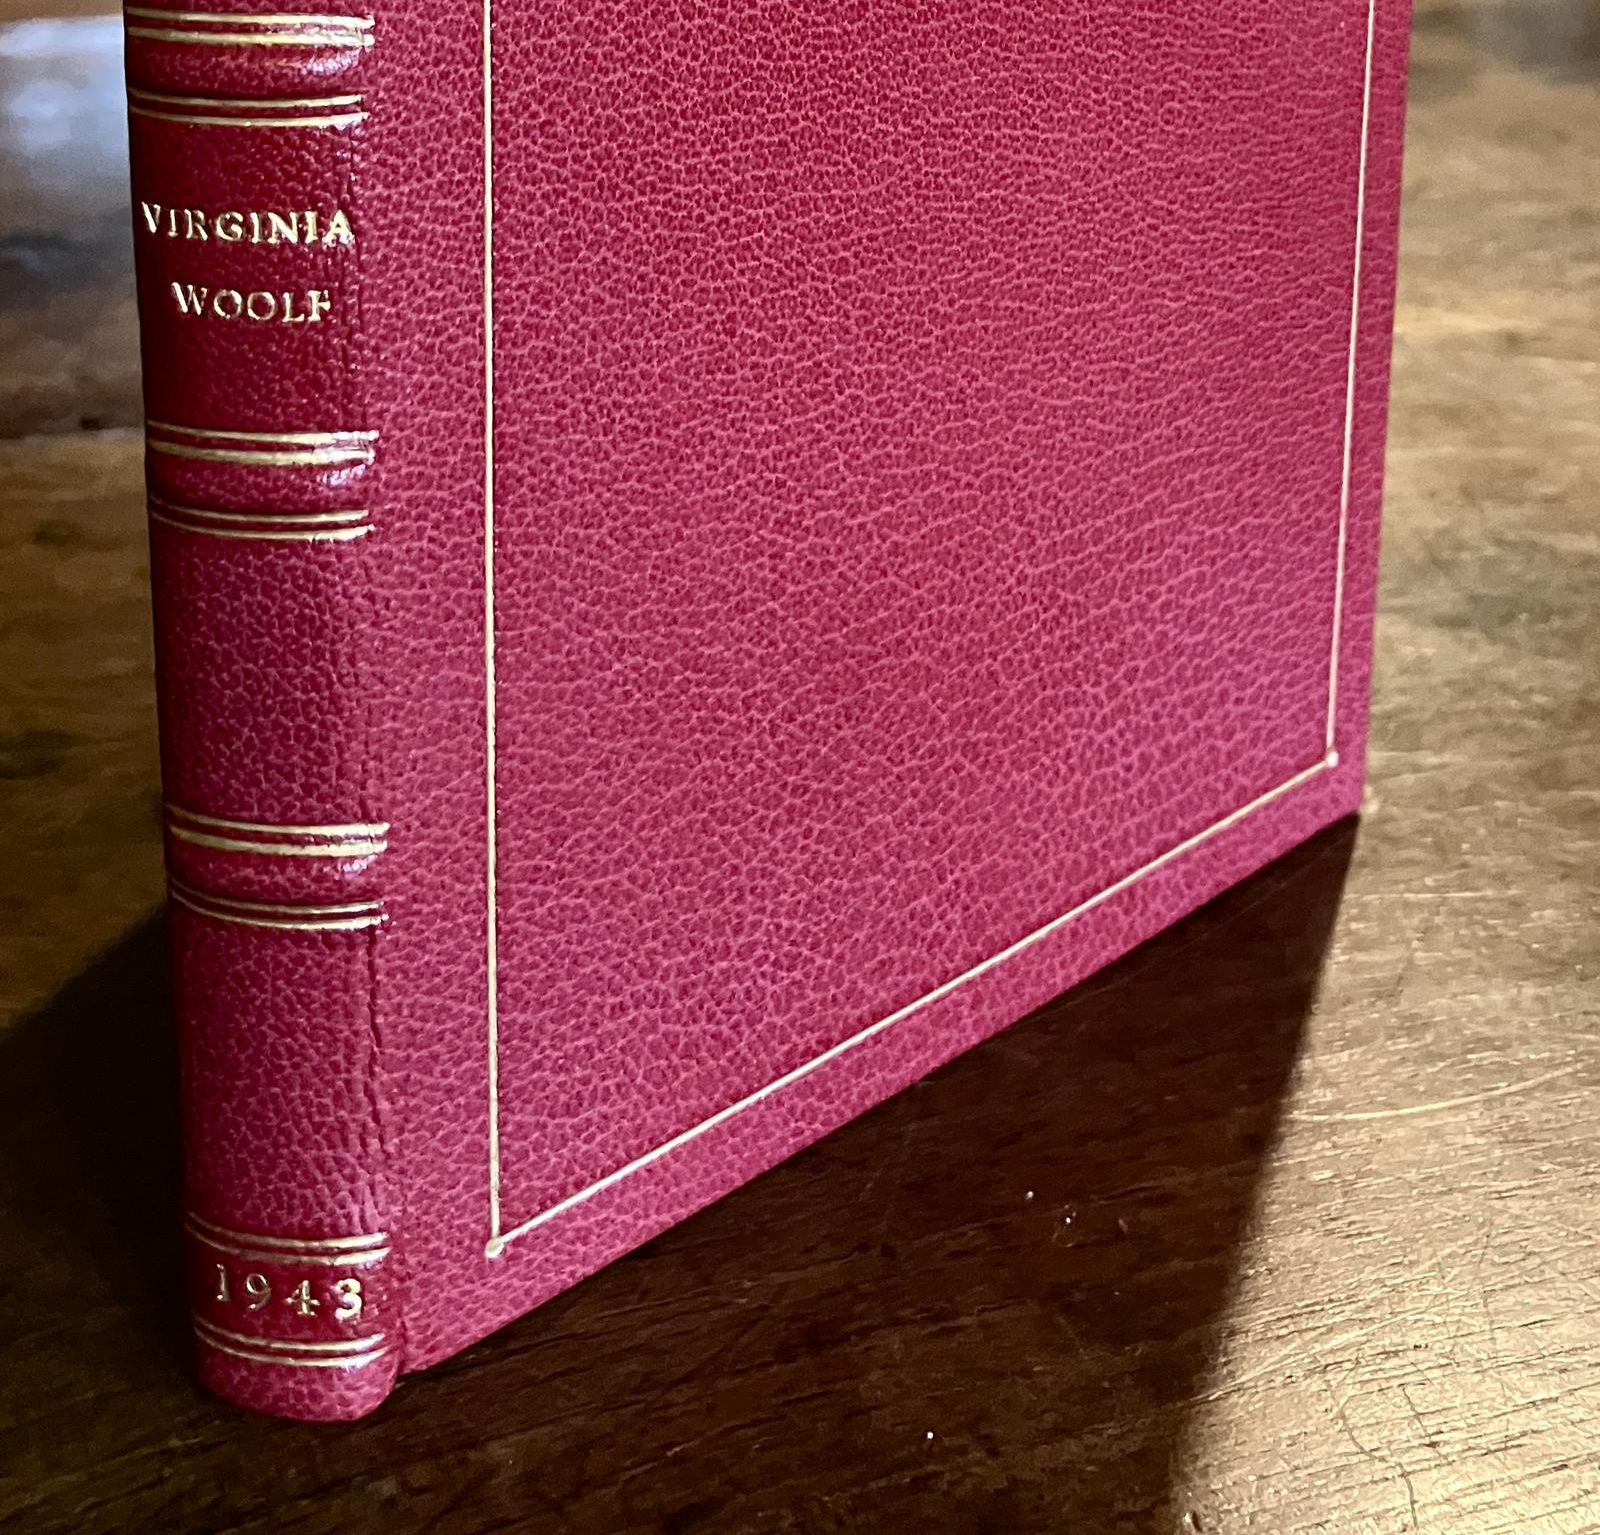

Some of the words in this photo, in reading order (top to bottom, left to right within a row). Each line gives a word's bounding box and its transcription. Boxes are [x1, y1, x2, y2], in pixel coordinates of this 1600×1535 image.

[142, 201, 354, 245] VIRGINIA
[171, 281, 332, 322] WOOLF
[216, 1263, 363, 1322] 1943
